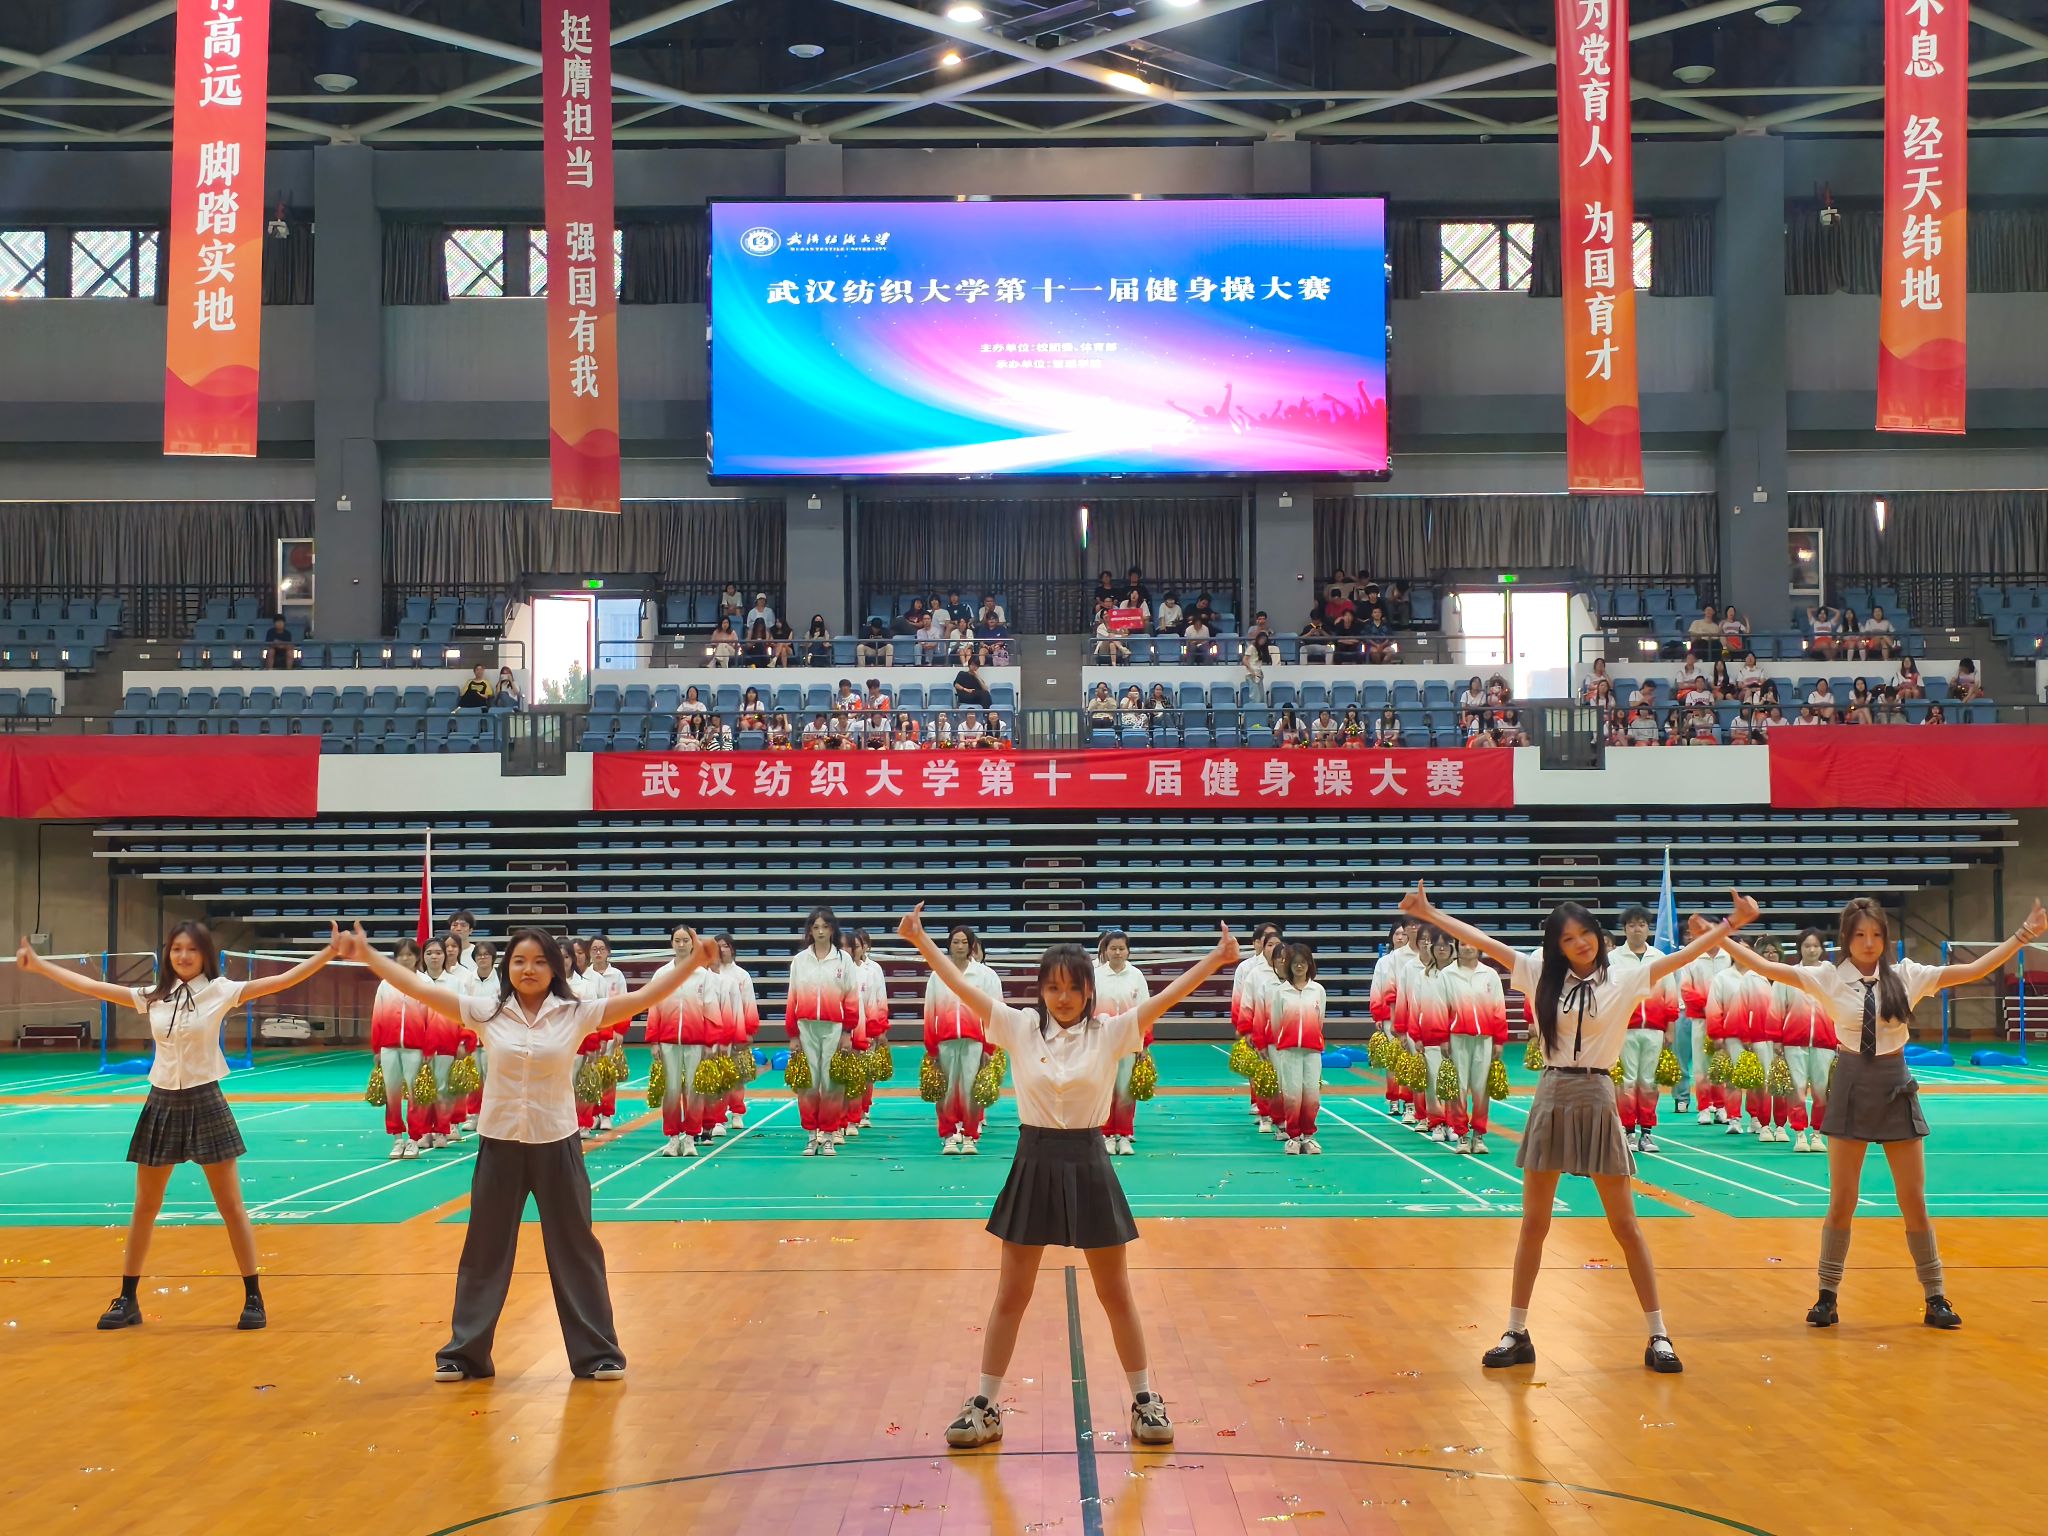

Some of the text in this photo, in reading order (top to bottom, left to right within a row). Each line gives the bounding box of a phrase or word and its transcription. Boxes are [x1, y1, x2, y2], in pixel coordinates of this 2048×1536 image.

[193, 0, 243, 332] 高远 脚踏实地
[560, 9, 599, 398] 挺膺担当 强国有我
[767, 276, 1331, 305] 武汉纺织大学第十一届健身操大赛
[1575, 0, 1620, 381] 为党育人 为国育才
[1900, 114, 1943, 311] 经天纬地
[641, 758, 1464, 797] 武汉纺织大学第十一届健身操大赛
